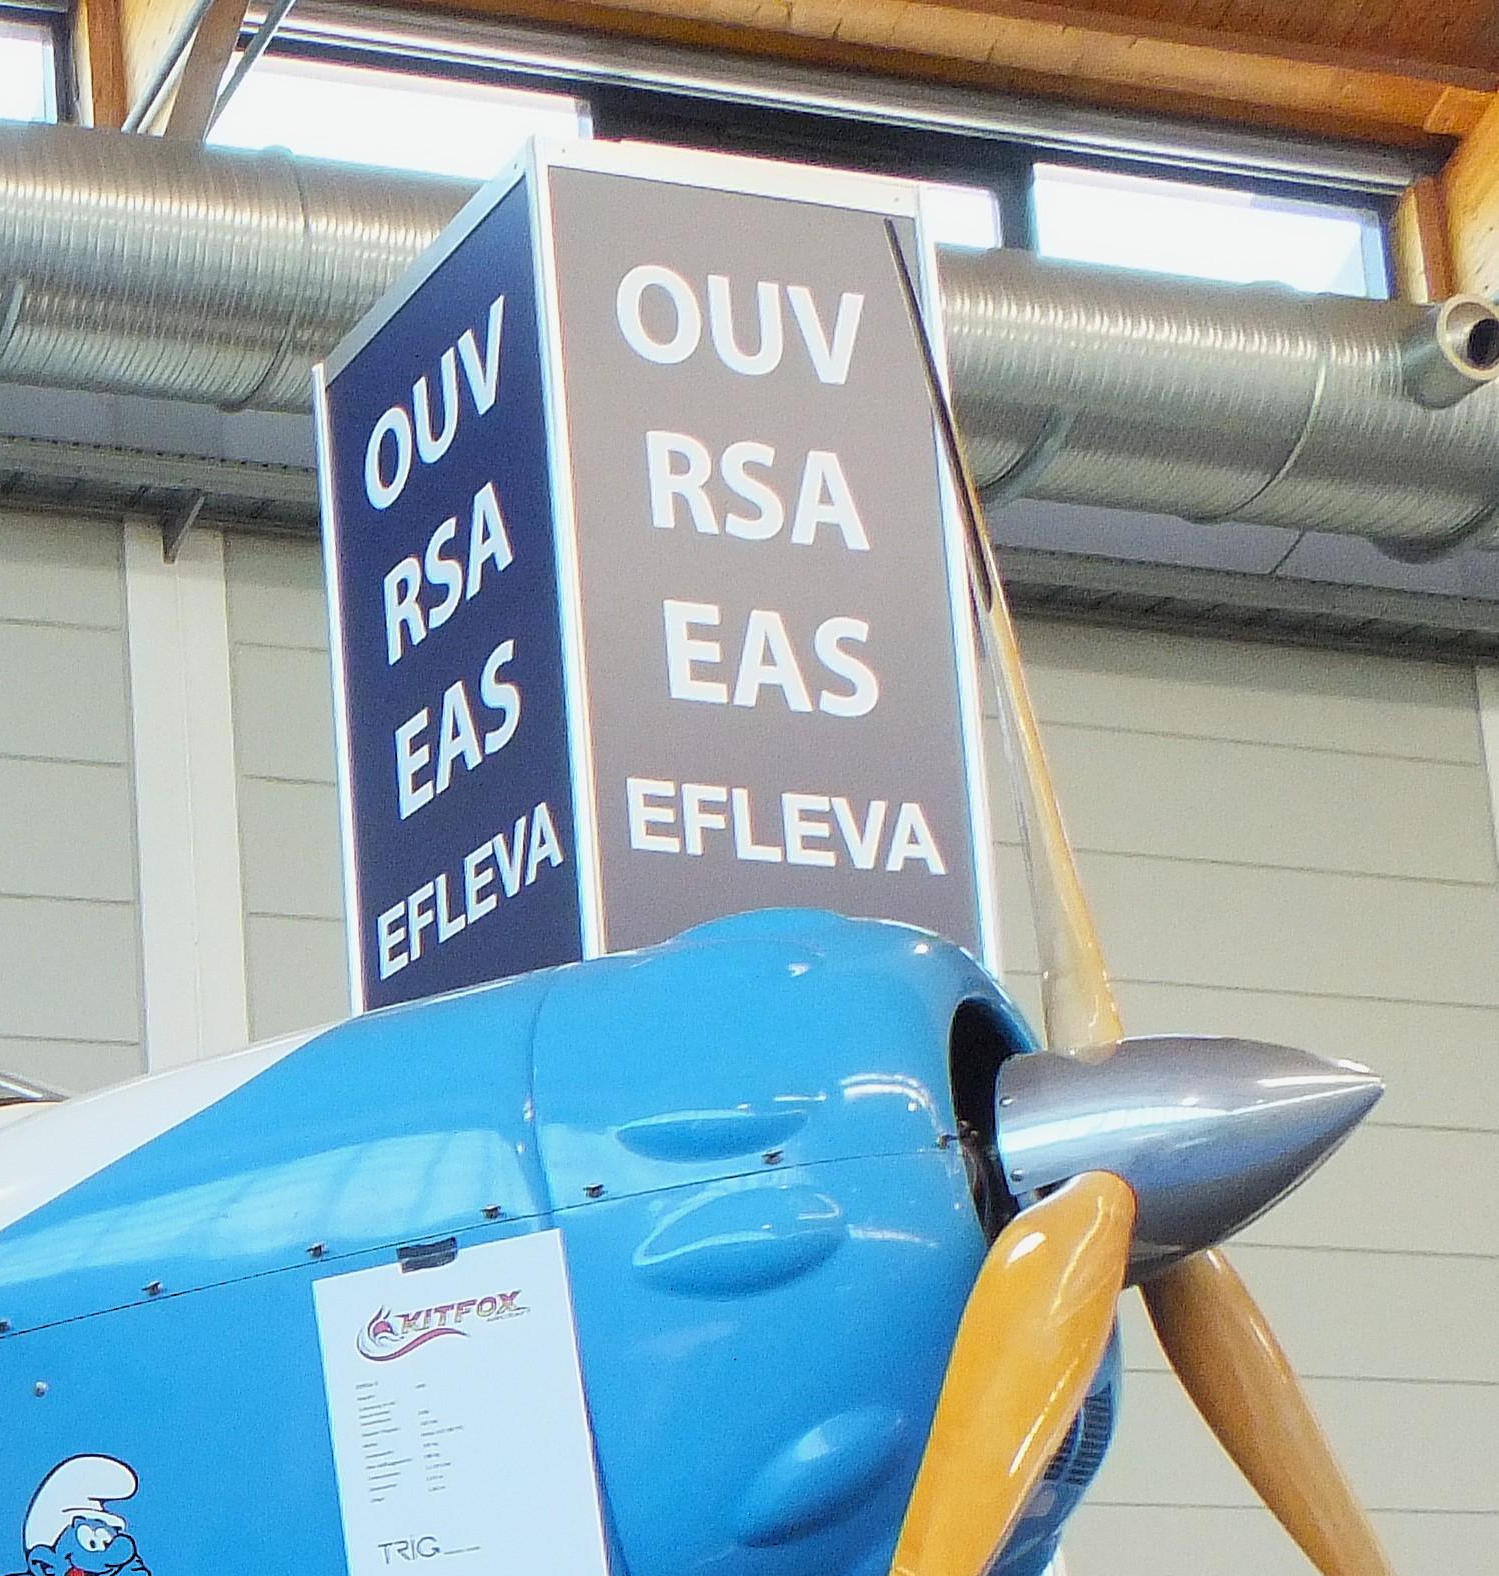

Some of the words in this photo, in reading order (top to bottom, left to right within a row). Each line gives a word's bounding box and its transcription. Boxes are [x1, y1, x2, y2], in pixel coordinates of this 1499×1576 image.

[616, 264, 866, 385] OUV
[365, 296, 504, 509] OUV
[645, 431, 870, 551] RSA
[382, 482, 514, 666] RSA
[663, 599, 880, 718] EAS
[394, 640, 521, 820] EAS
[627, 776, 947, 876] EFLEVA
[376, 803, 563, 981] EFLEVA
[395, 1290, 522, 1334] KITFOX
[378, 1535, 440, 1564] TRIG
